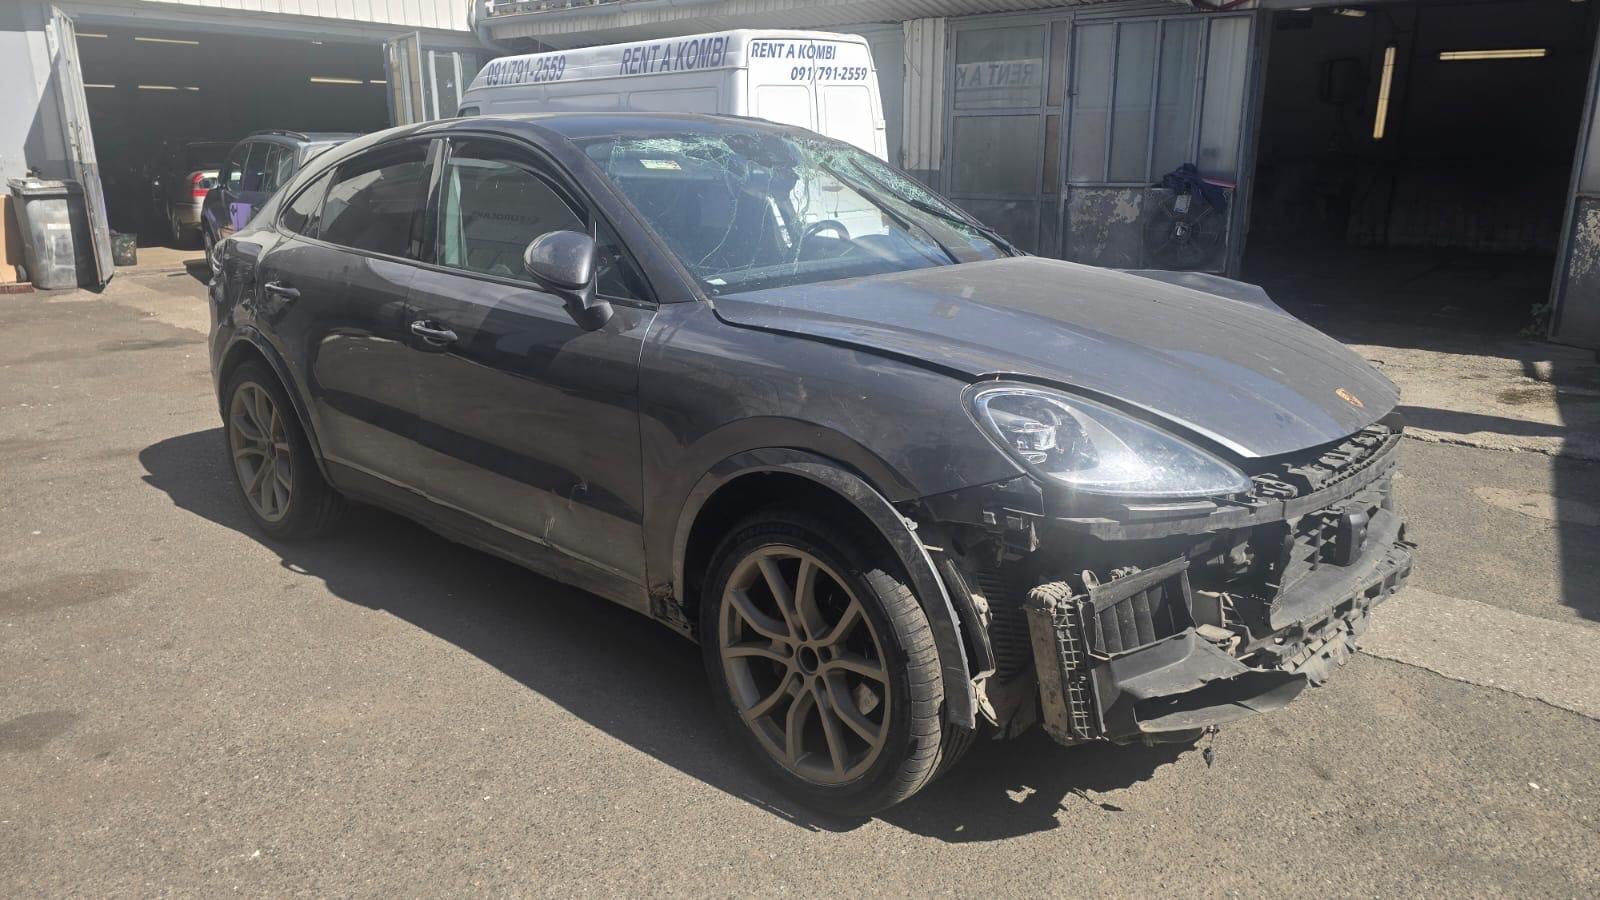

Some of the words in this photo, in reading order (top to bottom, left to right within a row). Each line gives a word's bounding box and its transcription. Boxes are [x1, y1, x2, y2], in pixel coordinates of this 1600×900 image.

[619, 45, 661, 75] RENT
[660, 43, 671, 72] A
[674, 36, 730, 71] KOMBI
[751, 42, 785, 58] RENT
[786, 43, 795, 59] A
[798, 44, 837, 60] KOMBI
[486, 54, 566, 86] 091/791-2559
[790, 66, 868, 85] 091/791-2559
